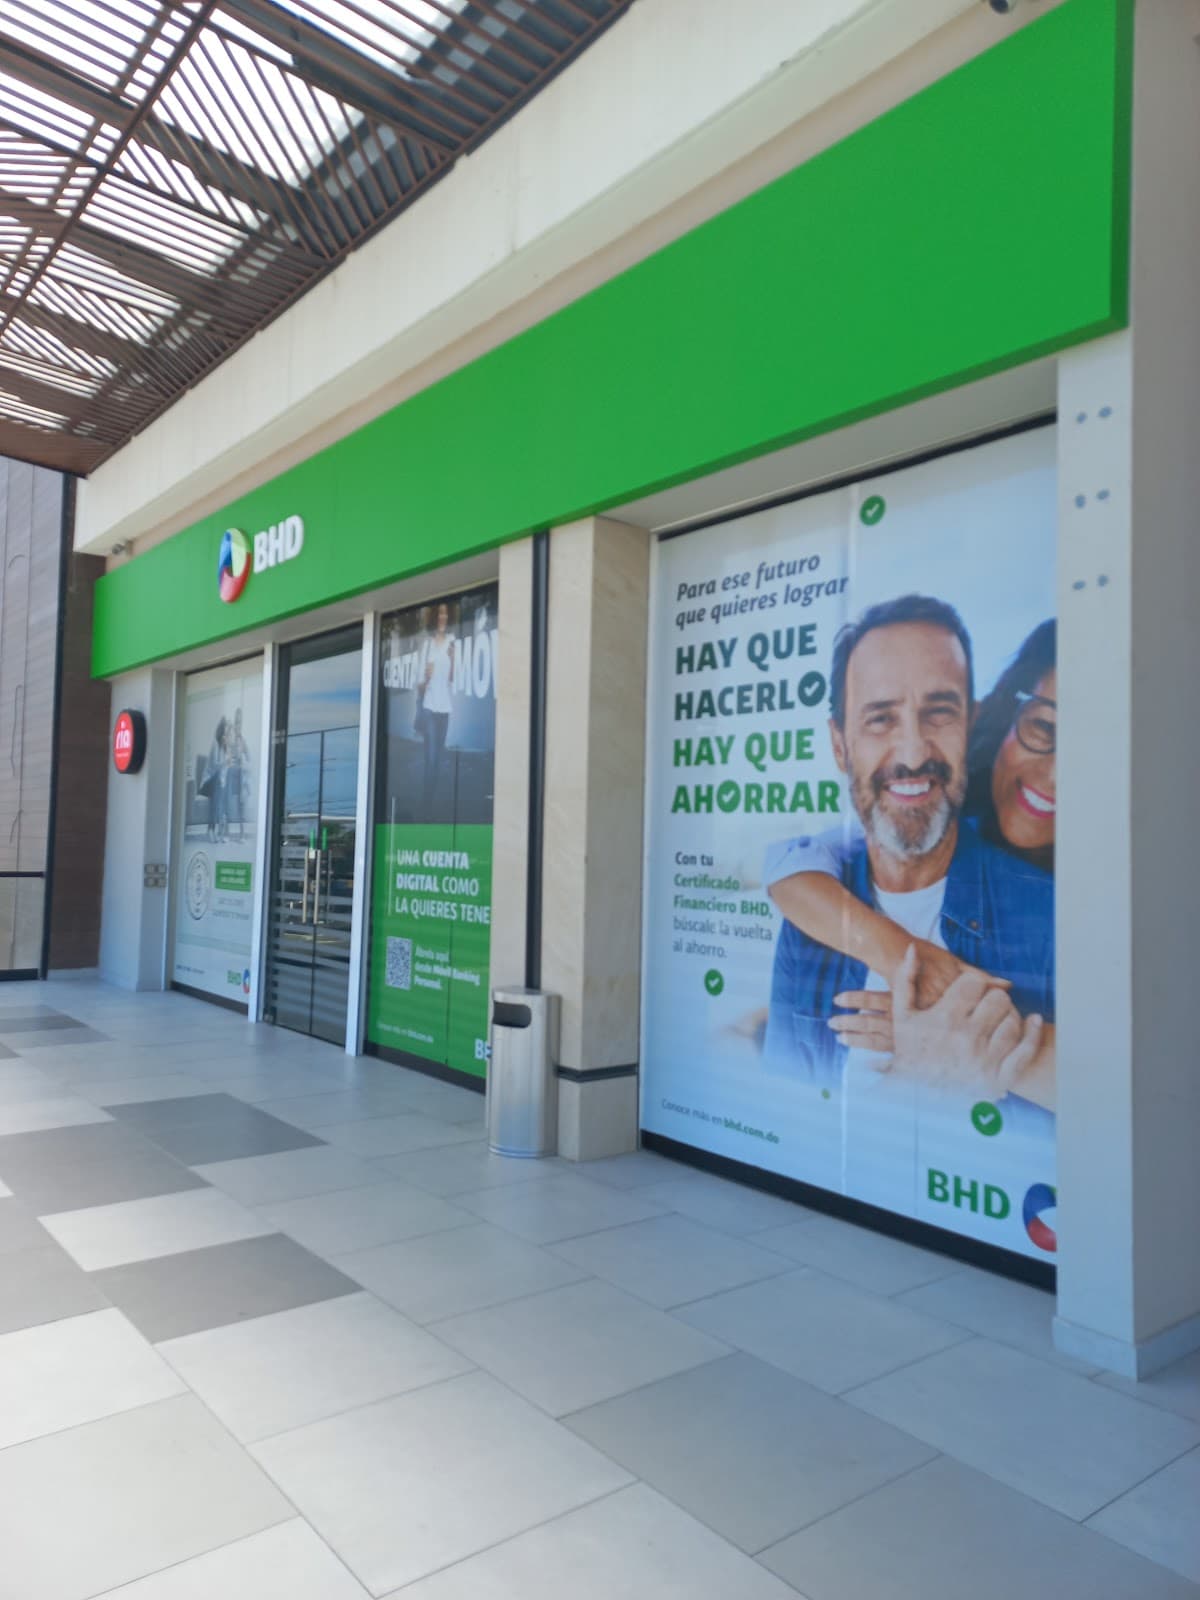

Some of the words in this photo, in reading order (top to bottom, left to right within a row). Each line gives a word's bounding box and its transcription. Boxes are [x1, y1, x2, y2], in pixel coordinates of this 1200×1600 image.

[253, 514, 304, 573] BHD
[676, 579, 716, 602] Para
[721, 570, 751, 591] ese
[755, 554, 821, 589] futuro
[675, 607, 706, 631] que
[710, 594, 777, 624] quieres
[783, 577, 848, 607] lograr
[675, 637, 738, 675] HAY
[747, 623, 817, 672] QUE
[116, 720, 131, 749] ria
[673, 734, 736, 767] HAY
[744, 728, 815, 772] QUE
[671, 779, 841, 814] AHORRAR
[396, 849, 420, 866] UNA
[422, 851, 469, 870] CUENTA
[675, 851, 697, 866] Con
[701, 853, 714, 866] tu
[396, 873, 439, 893] DIGITAL
[442, 877, 479, 897] COMO
[673, 873, 740, 891] Certificado
[395, 897, 408, 914] LA
[411, 899, 458, 921] QUIERES
[673, 895, 737, 914] Financiero
[740, 901, 773, 919] BHD,
[719, 920, 730, 936] la
[733, 924, 773, 941] vuelta
[673, 938, 683, 952] al
[685, 940, 727, 958] ahorro.
[661, 1098, 690, 1115] Conoce
[723, 1117, 780, 1144] bhd.com.do
[927, 1168, 1010, 1220] BHD
